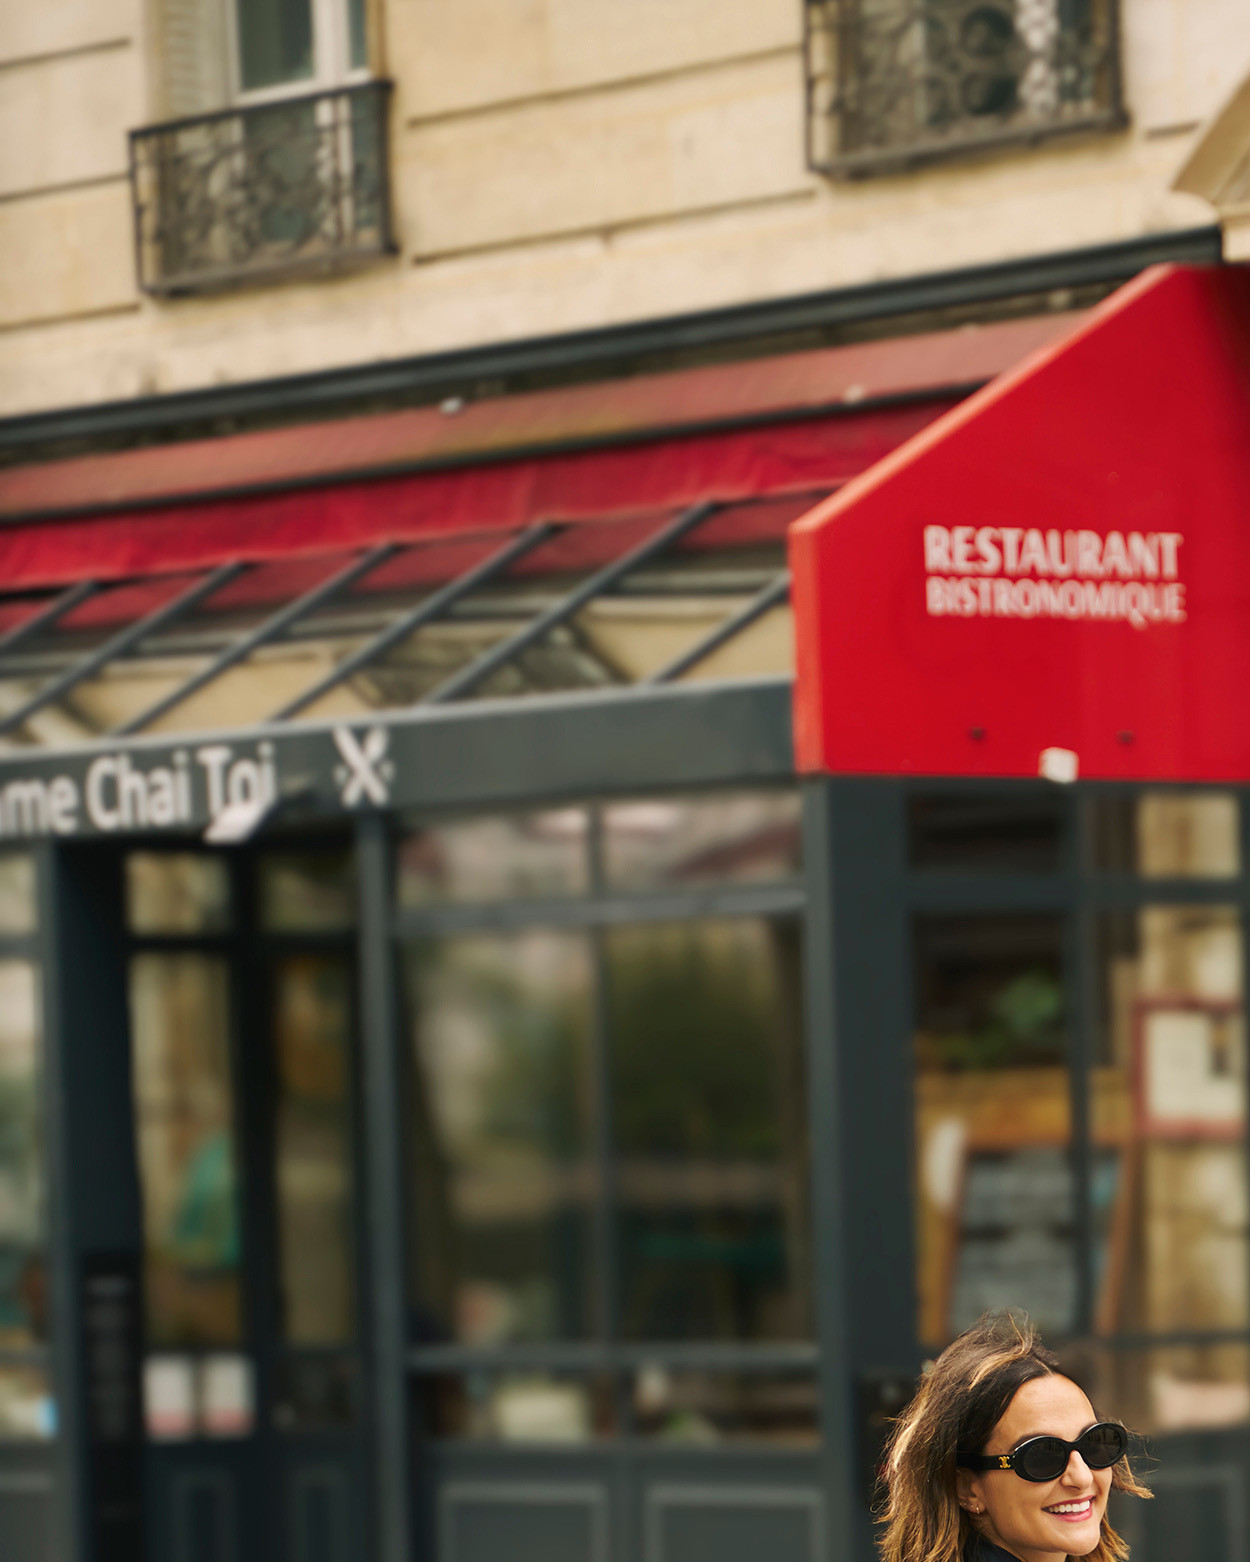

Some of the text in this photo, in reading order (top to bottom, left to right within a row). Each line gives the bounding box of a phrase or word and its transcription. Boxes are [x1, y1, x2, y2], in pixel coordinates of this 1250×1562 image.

[924, 524, 1183, 579] RESTAURANT
[926, 576, 1187, 630] BISTRONOMIQUE
[0, 741, 275, 835] me Chai Toi
